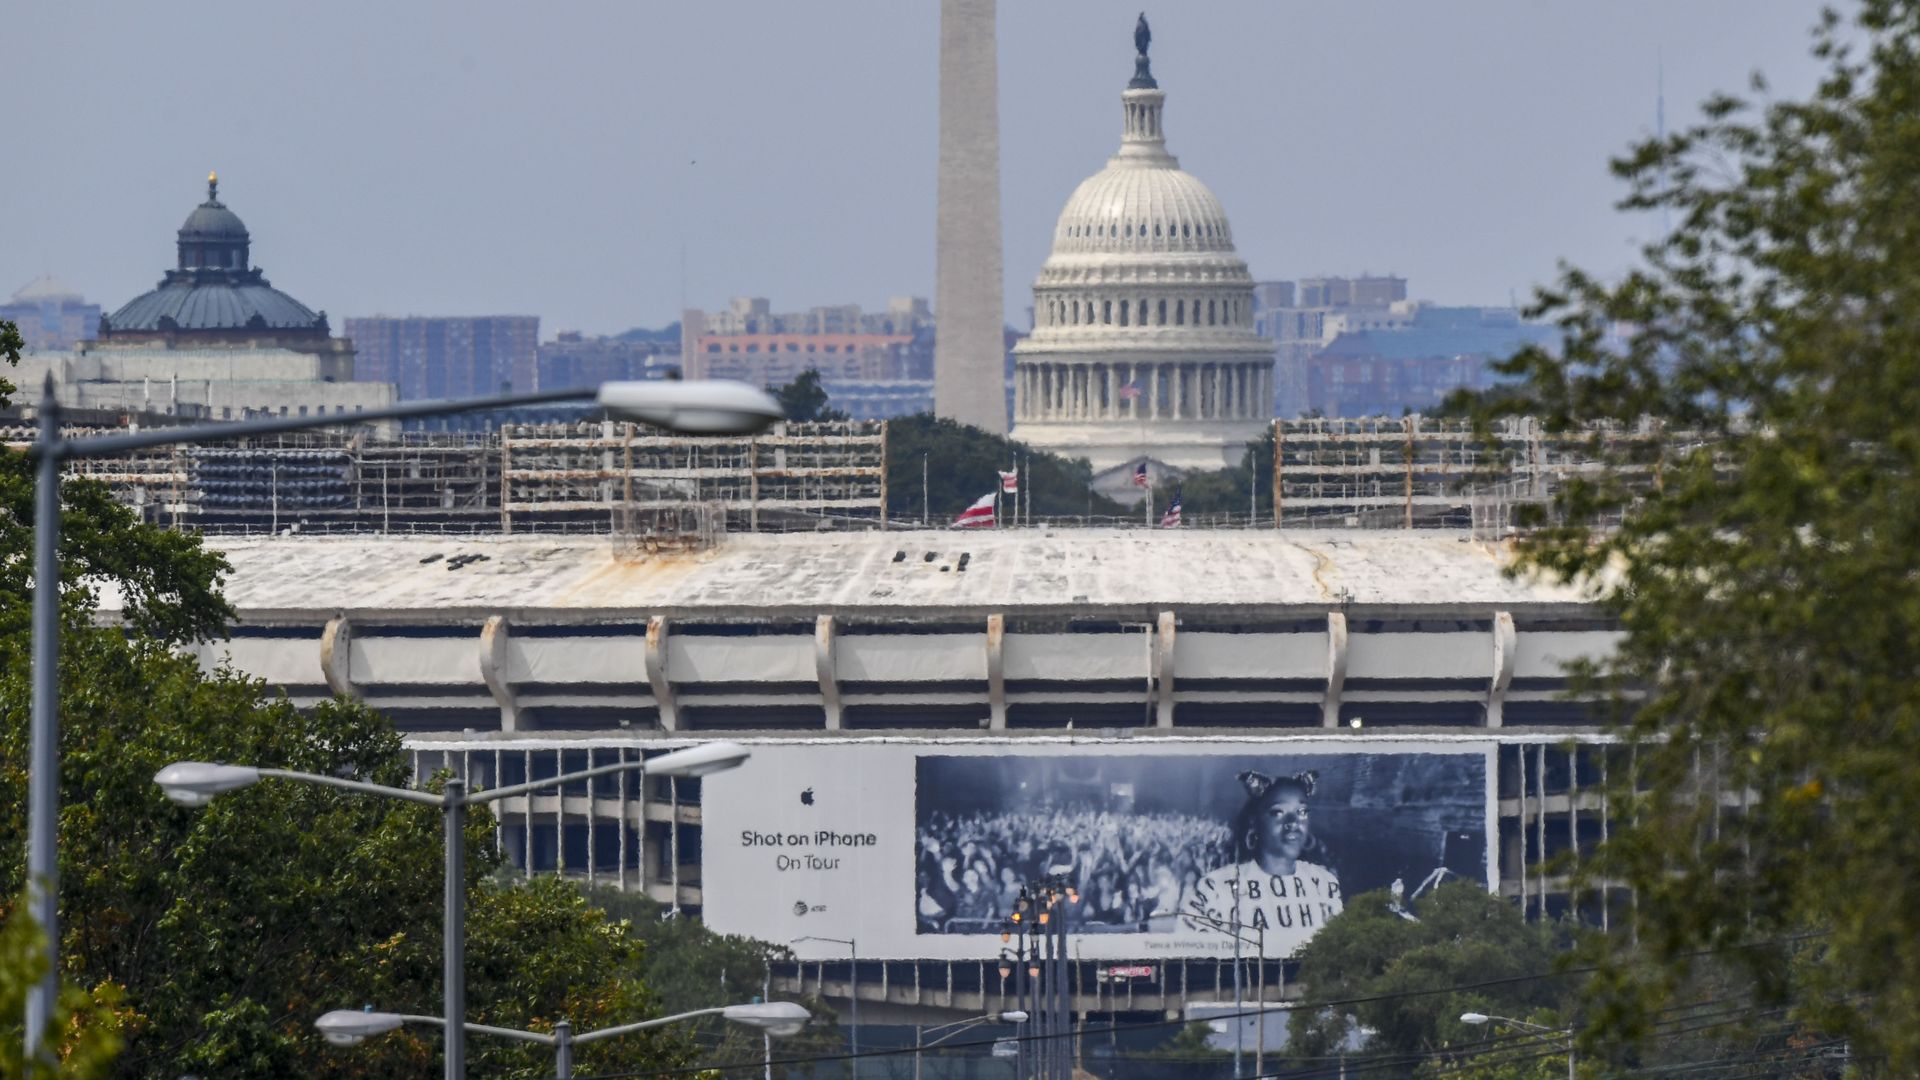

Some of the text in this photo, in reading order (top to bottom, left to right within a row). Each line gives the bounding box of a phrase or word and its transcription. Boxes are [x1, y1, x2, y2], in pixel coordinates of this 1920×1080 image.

[742, 831, 877, 847] Shot on iPhone
[777, 854, 840, 871] On Tour
